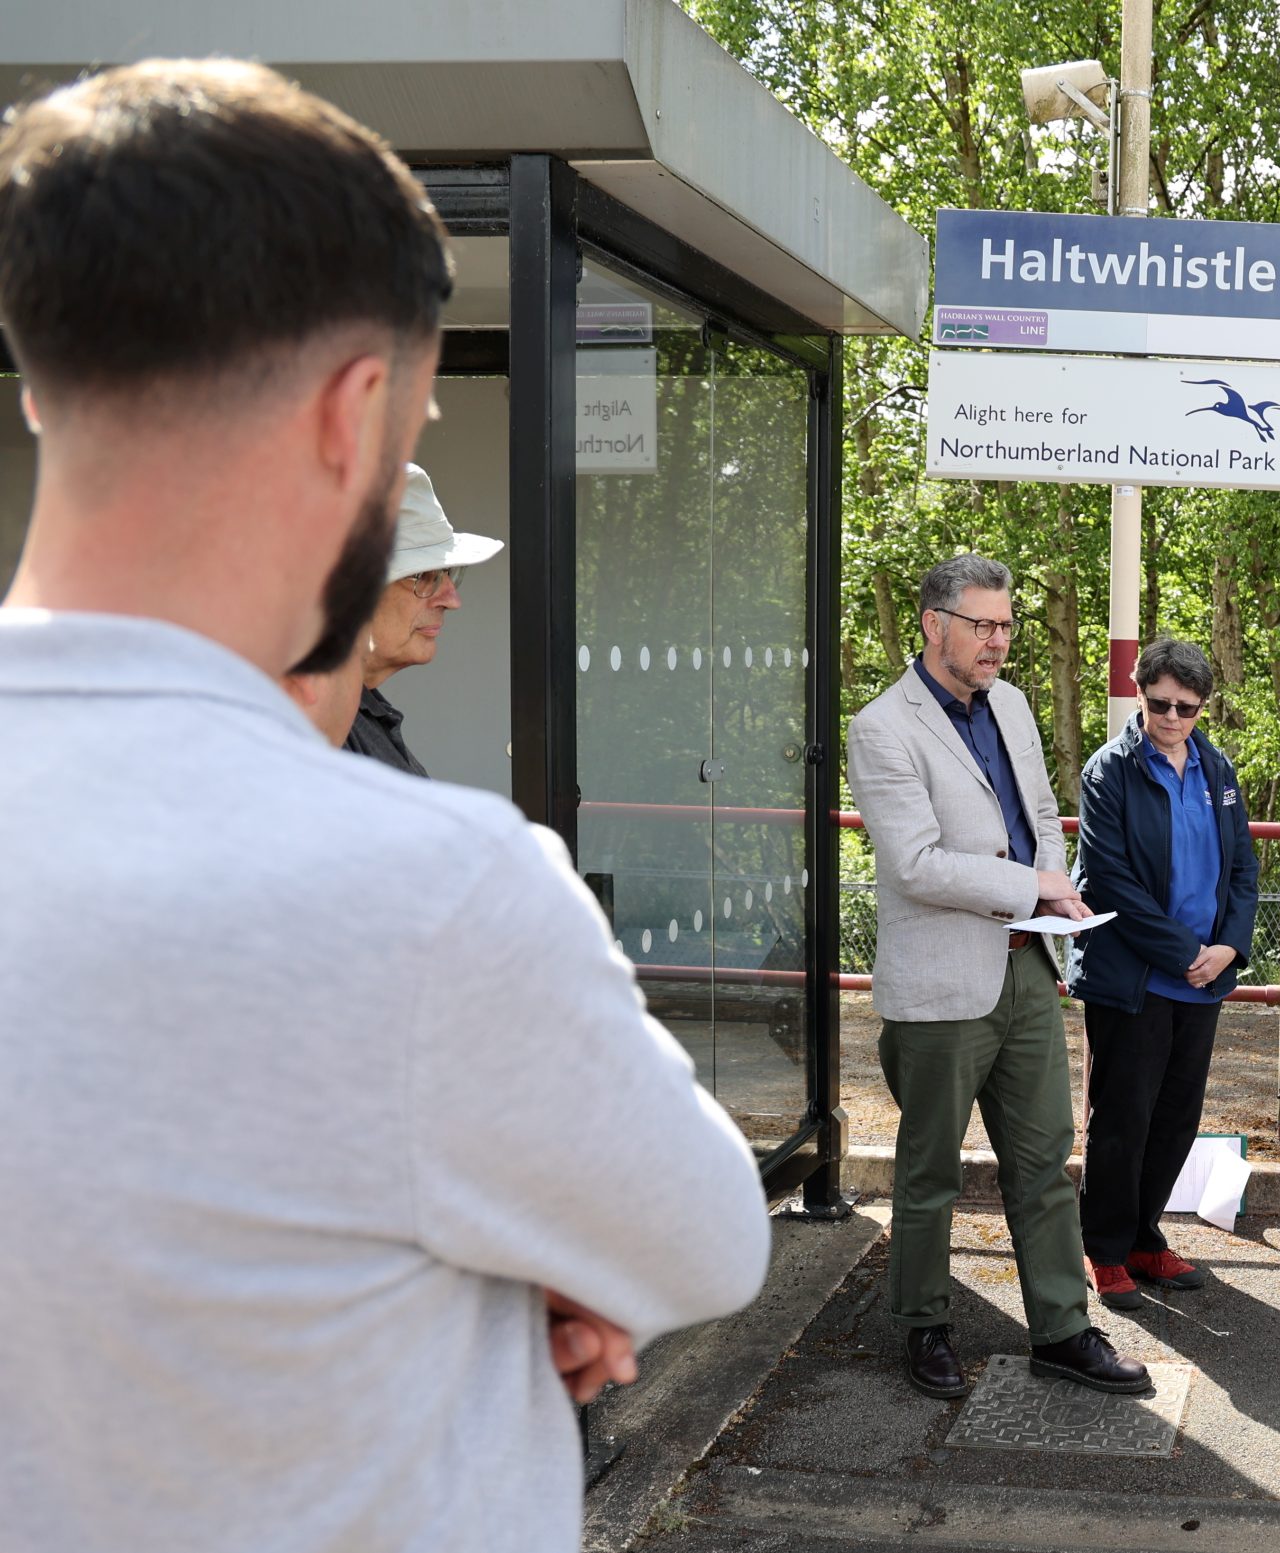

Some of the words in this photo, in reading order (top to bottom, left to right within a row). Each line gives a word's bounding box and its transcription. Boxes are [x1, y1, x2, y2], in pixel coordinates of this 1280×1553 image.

[981, 238, 1277, 292] Haltwhistle
[941, 312, 983, 321] HADRIAN'S
[985, 313, 1006, 321] WALL
[1007, 315, 1046, 323] COUNTRY
[1020, 325, 1045, 335] LINE
[954, 403, 1006, 427] Alight
[1015, 406, 1053, 424] here
[1061, 407, 1088, 425] for
[940, 437, 1120, 465] Northumberland
[1129, 446, 1219, 469] National
[1229, 449, 1276, 472] Park
